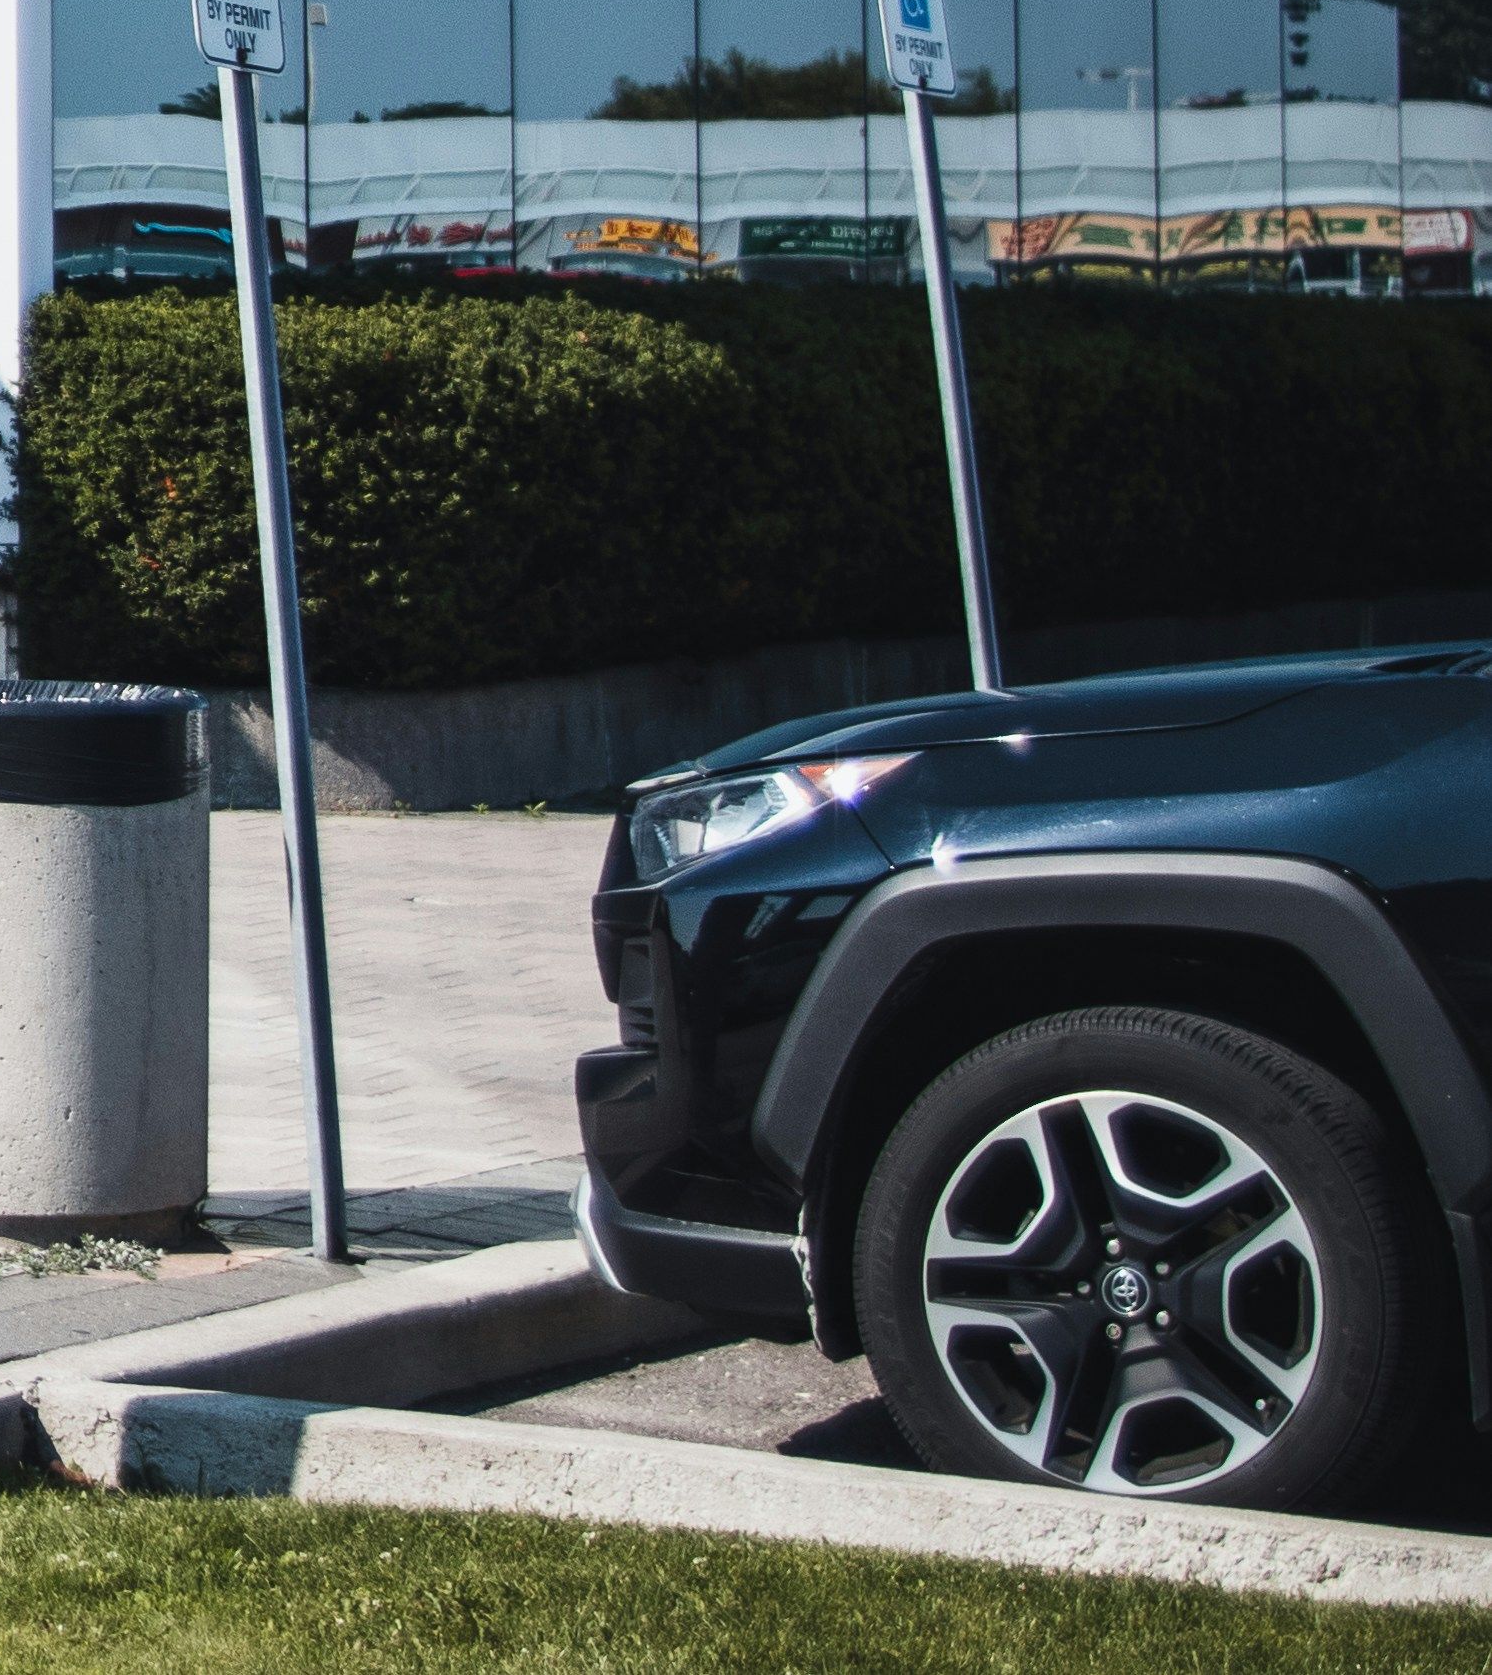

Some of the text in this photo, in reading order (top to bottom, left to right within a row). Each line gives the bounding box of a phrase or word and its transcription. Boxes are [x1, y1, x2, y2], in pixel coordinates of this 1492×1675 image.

[225, 1, 271, 31] PERMIT
[225, 27, 257, 55] ONLY
[895, 33, 944, 60] BY PERMIT
[909, 57, 933, 79] ONLY
